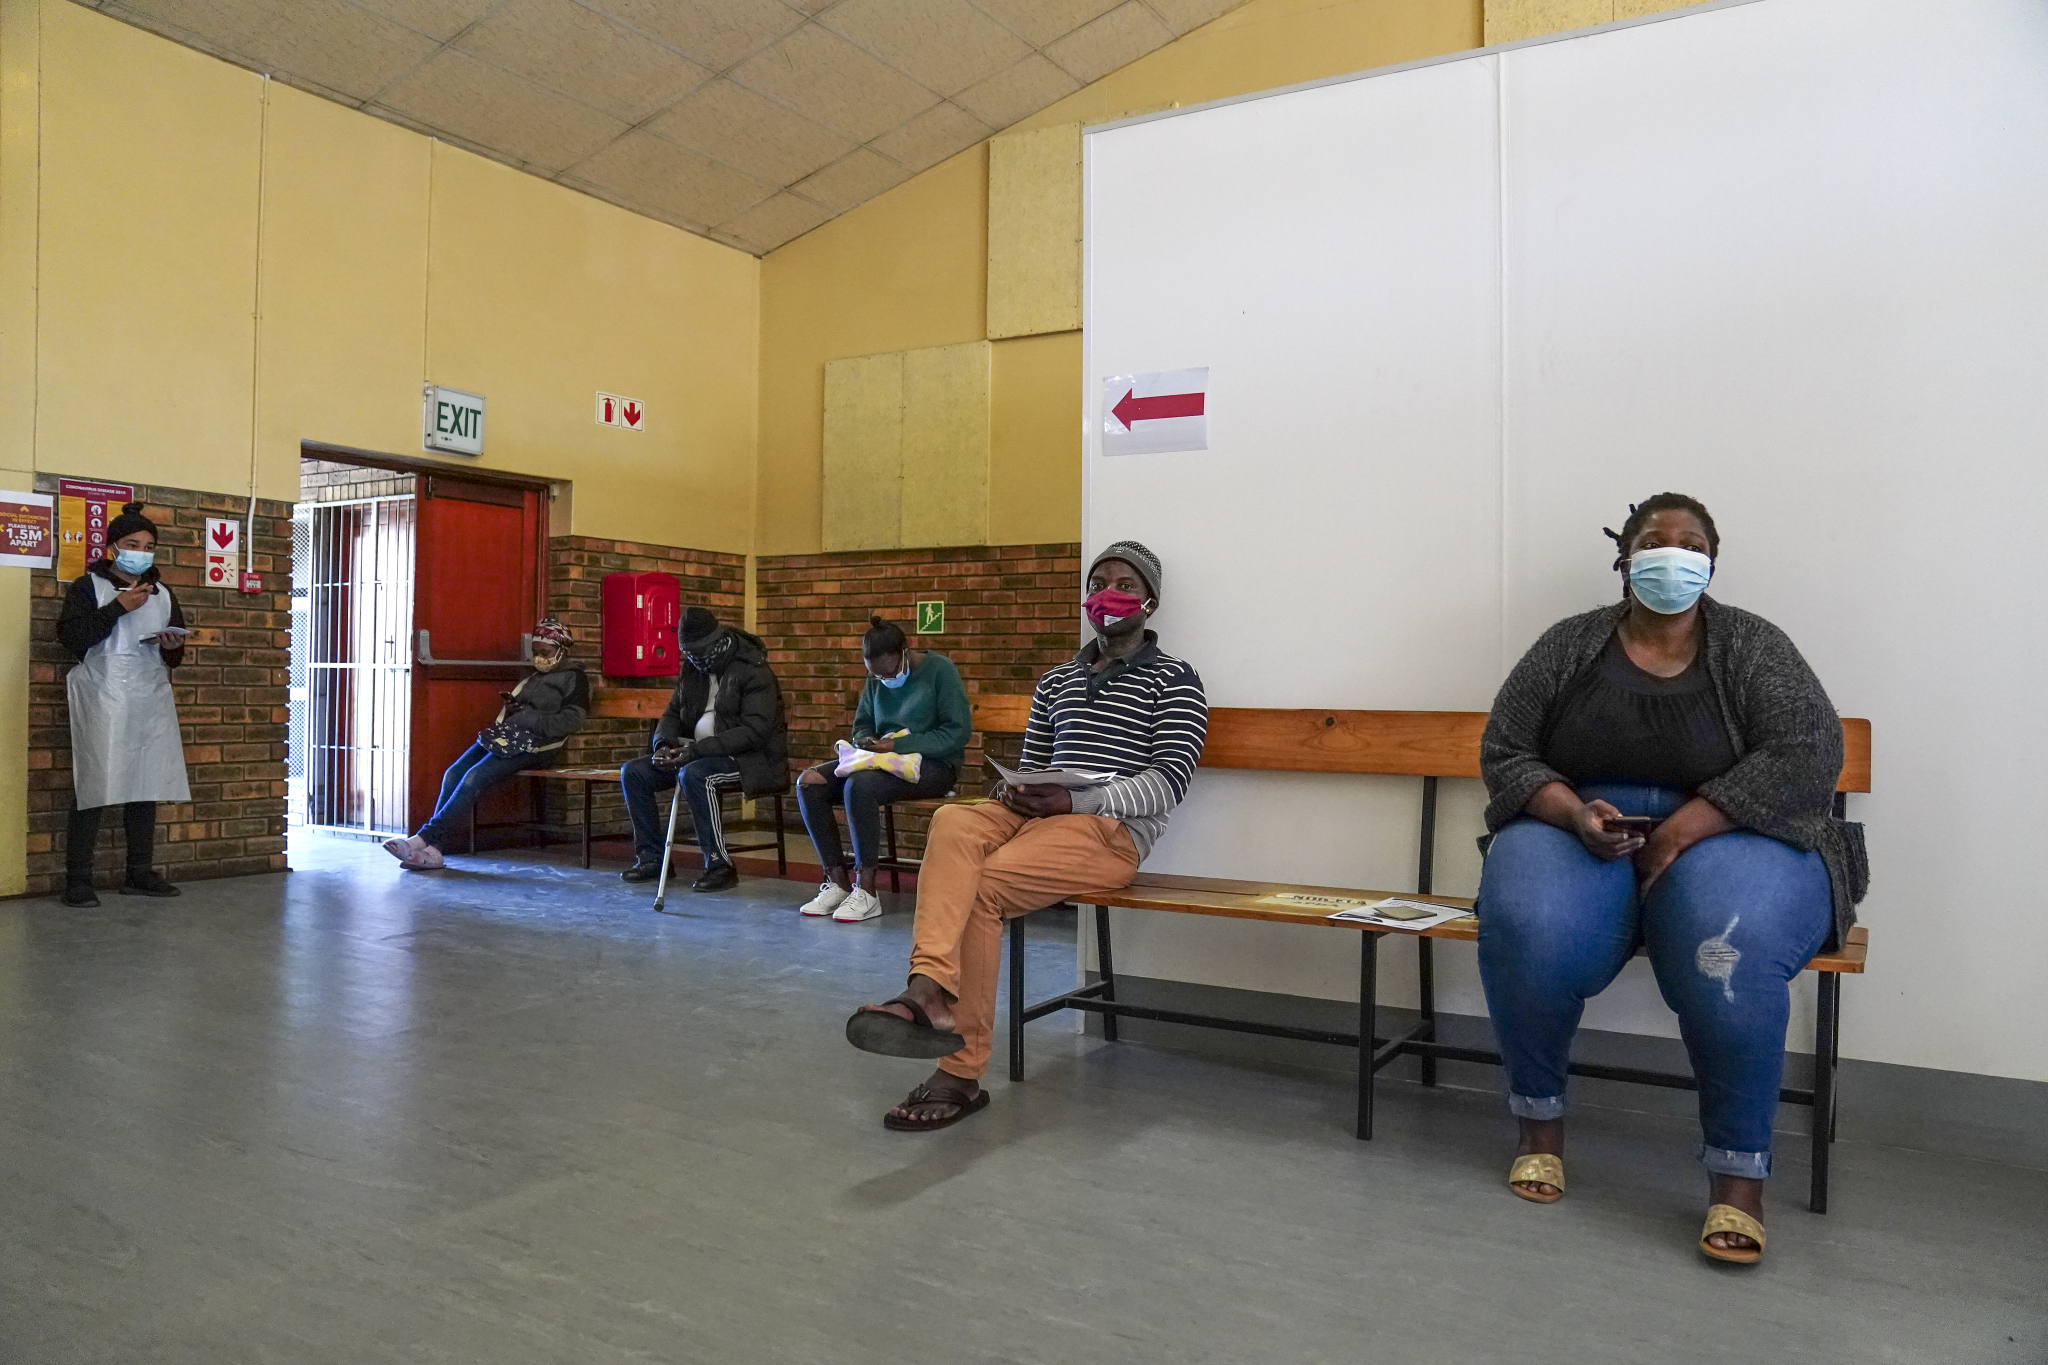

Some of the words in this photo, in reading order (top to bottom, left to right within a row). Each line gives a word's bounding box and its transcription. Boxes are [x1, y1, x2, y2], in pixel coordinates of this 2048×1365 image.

[437, 401, 481, 439] EXIT
[66, 484, 97, 492] CORONAVIRUS
[6, 528, 42, 541] 1.5M
[10, 538, 38, 548] APART
